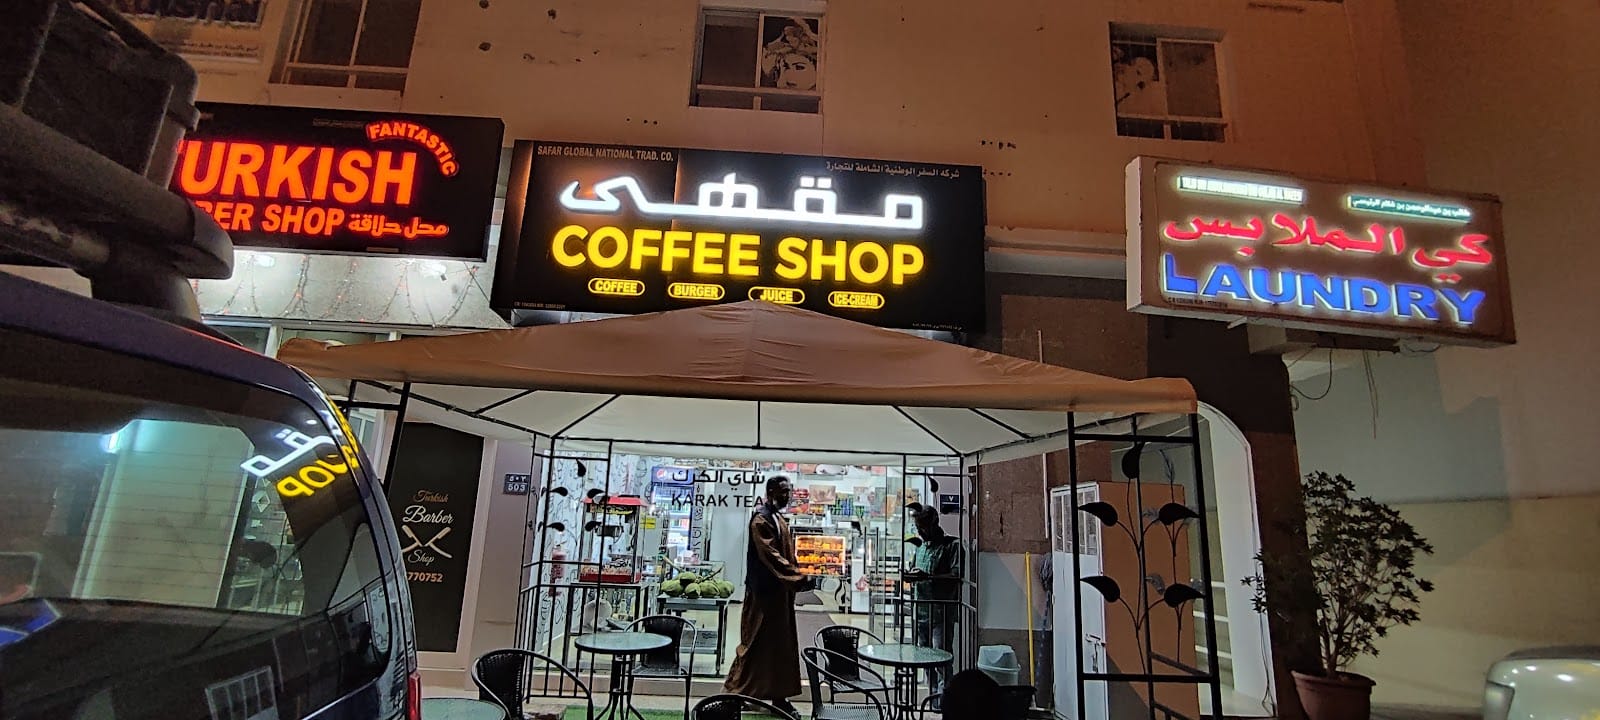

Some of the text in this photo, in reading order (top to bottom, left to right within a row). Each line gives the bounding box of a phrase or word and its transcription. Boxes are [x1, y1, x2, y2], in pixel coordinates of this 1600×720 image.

[367, 121, 458, 176] FANTASTIC
[537, 145, 674, 161] SAFAR GLOBAL NATIONAL TRAD. CO.
[177, 139, 417, 205] URKISH
[885, 164, 916, 177] الوطنية
[917, 167, 939, 177] السفر
[559, 172, 924, 230] مقهى
[261, 203, 345, 236] SHOP
[348, 213, 449, 238] محل حلاقة
[552, 225, 925, 285] COFFEE SHOP
[1162, 212, 1494, 283] كي الملابس
[594, 280, 638, 293] COFFEE
[673, 284, 719, 298] BURGER
[760, 288, 794, 302] JUICE
[1162, 253, 1487, 325] LAUNDRY
[833, 292, 879, 307] ICE-CREAM
[672, 469, 722, 487] الكرك
[727, 463, 765, 490] شاي
[508, 483, 526, 491] 503
[671, 493, 764, 510] KARAK TEA
[402, 504, 453, 524] Barber
[407, 549, 435, 566] Shop
